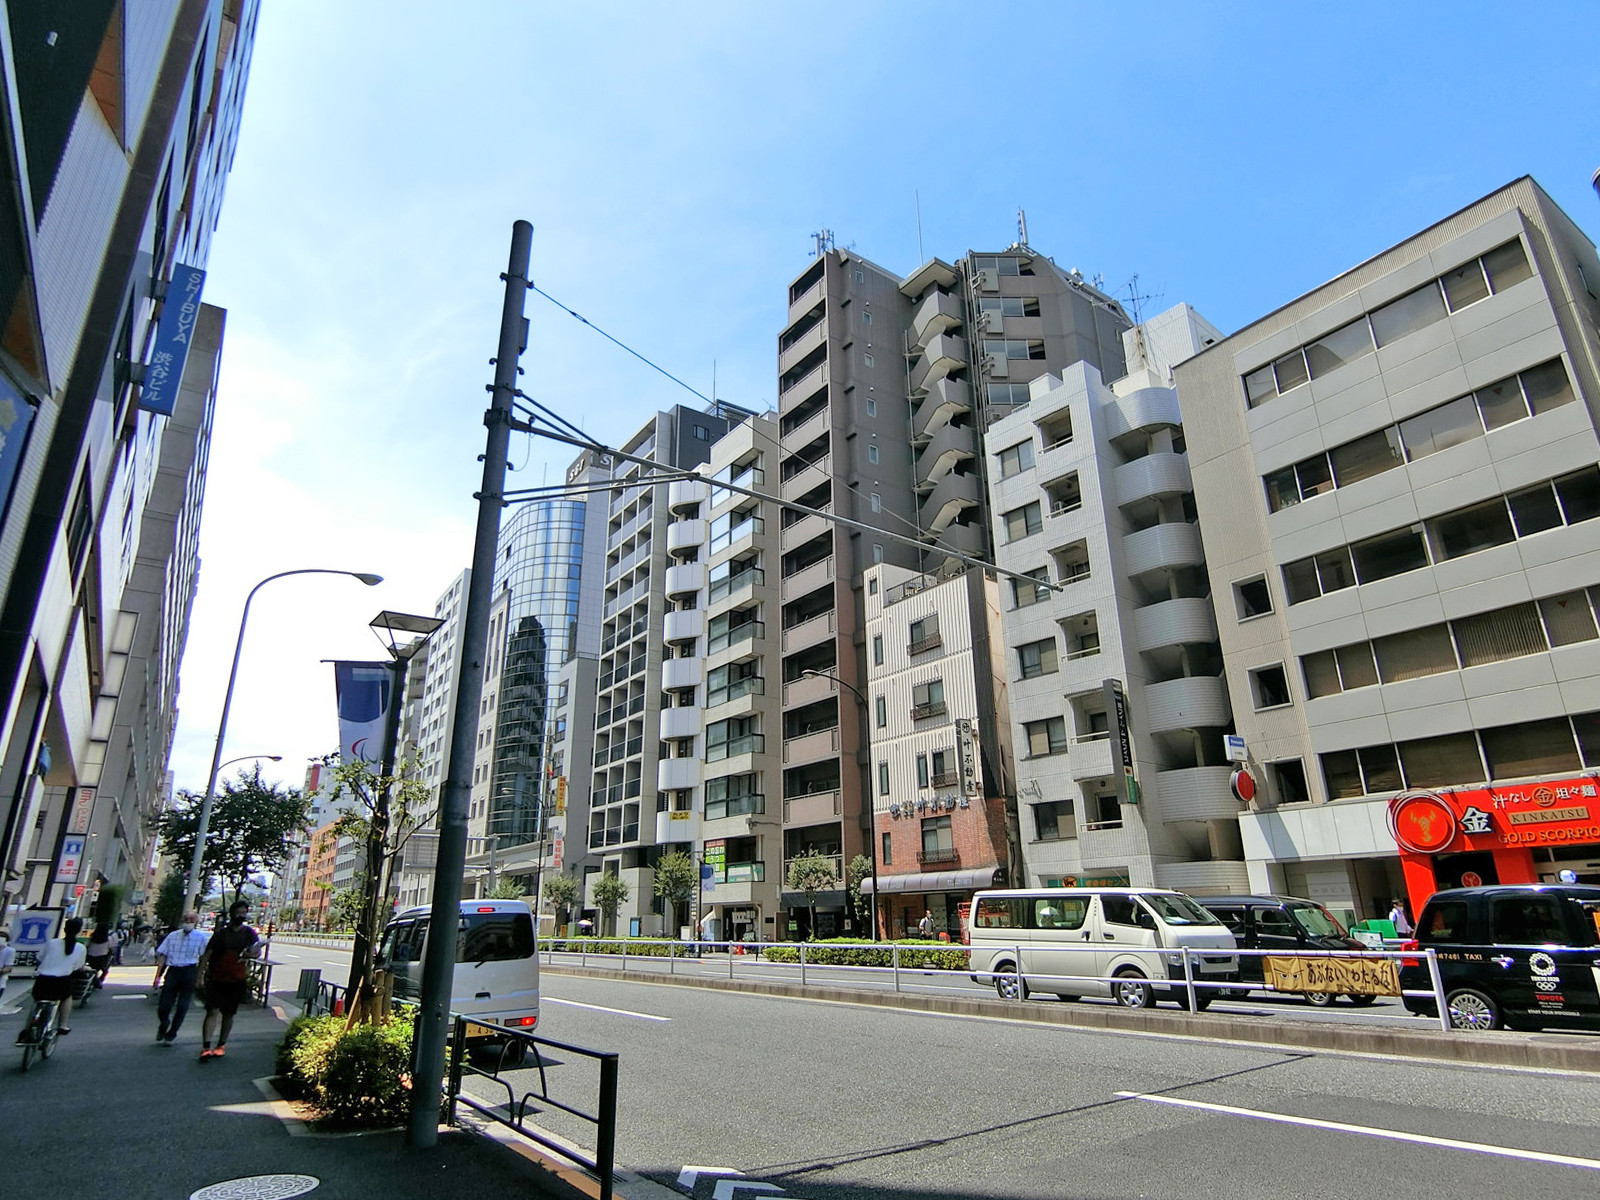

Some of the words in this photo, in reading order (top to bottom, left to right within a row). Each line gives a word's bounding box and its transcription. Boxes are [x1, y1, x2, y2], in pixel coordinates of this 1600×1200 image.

[172, 272, 203, 344] SHIBUYA
[962, 738, 975, 792] 叶不動産
[1460, 806, 1493, 834] 金
[1510, 808, 1586, 823] KINKATSU
[1498, 831, 1536, 844] GOLD
[1464, 953, 1483, 961] TAXI
[1535, 994, 1566, 1002] TOYOTA
